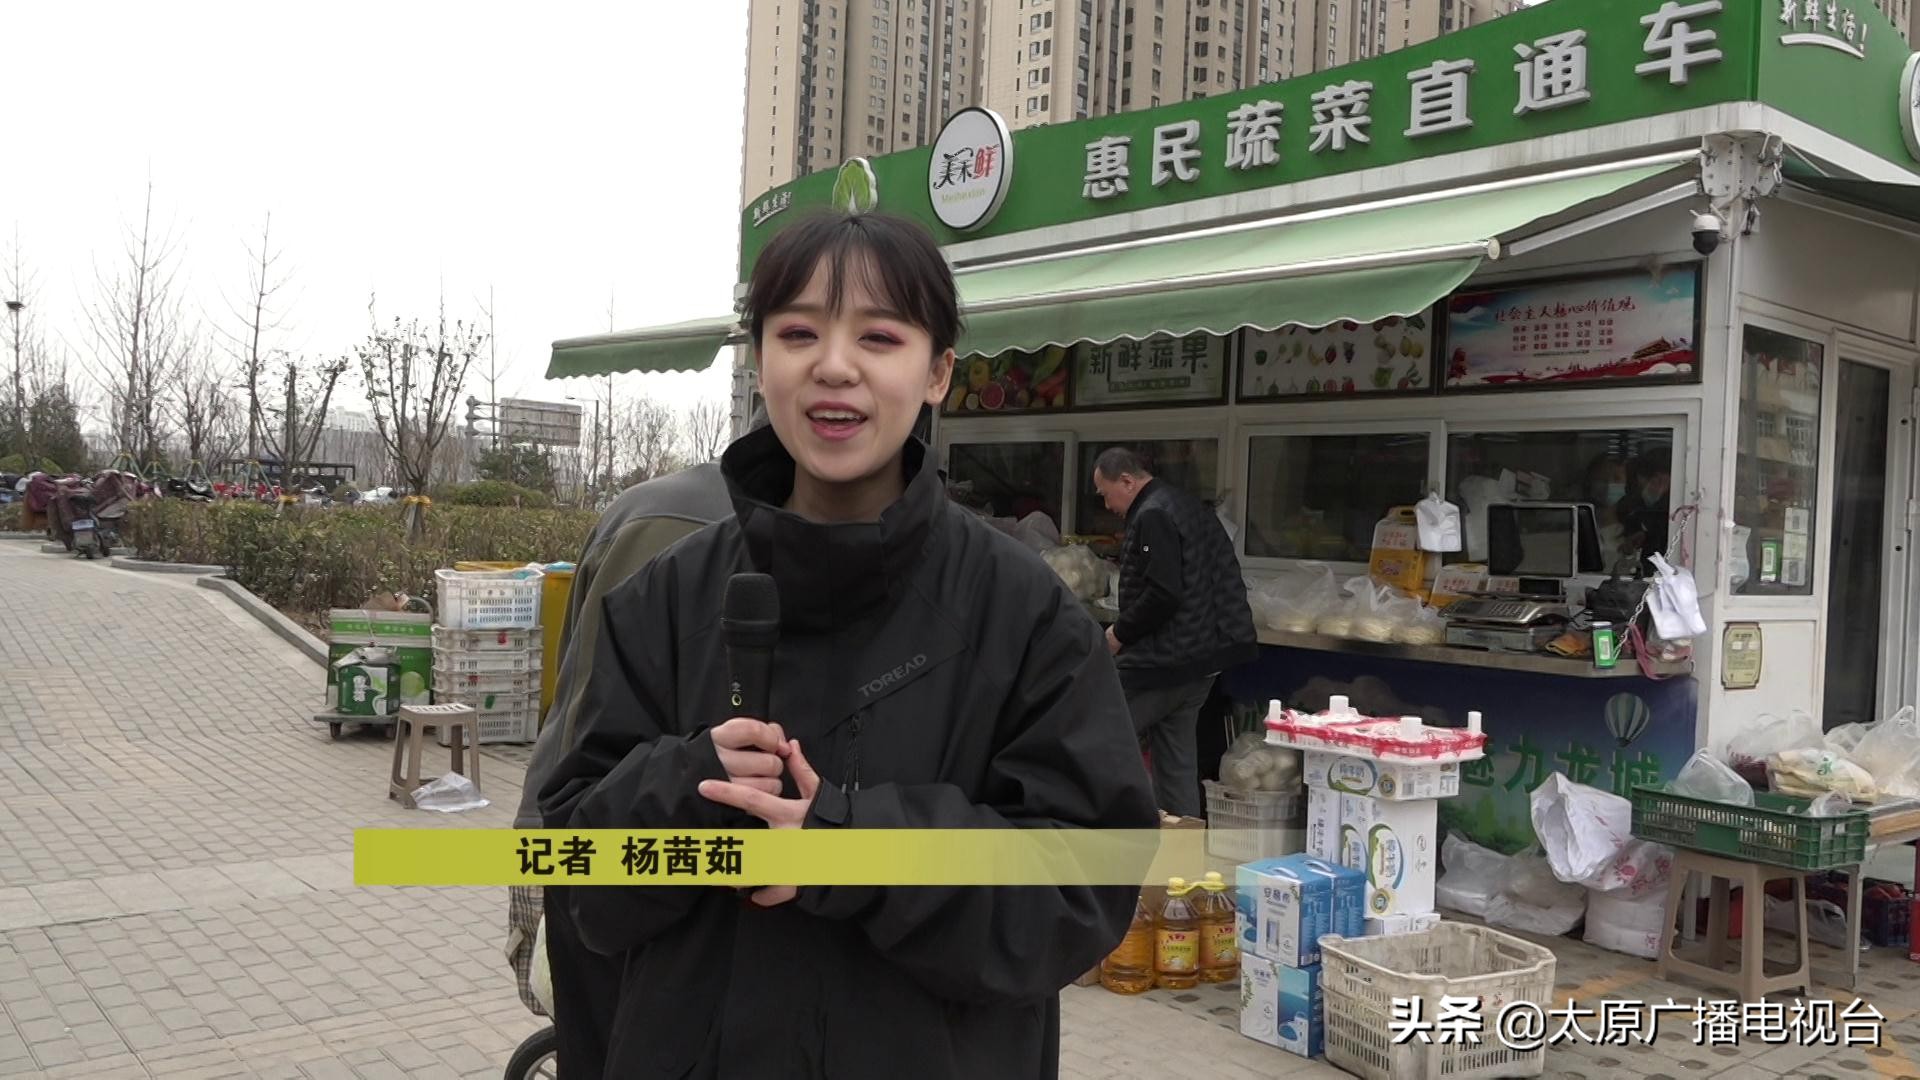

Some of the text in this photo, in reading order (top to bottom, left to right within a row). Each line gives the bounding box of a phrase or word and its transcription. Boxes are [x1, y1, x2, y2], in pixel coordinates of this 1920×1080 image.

[1082, 0, 1723, 199] 惠民蔬菜直通车
[857, 653, 927, 697] TOREAD
